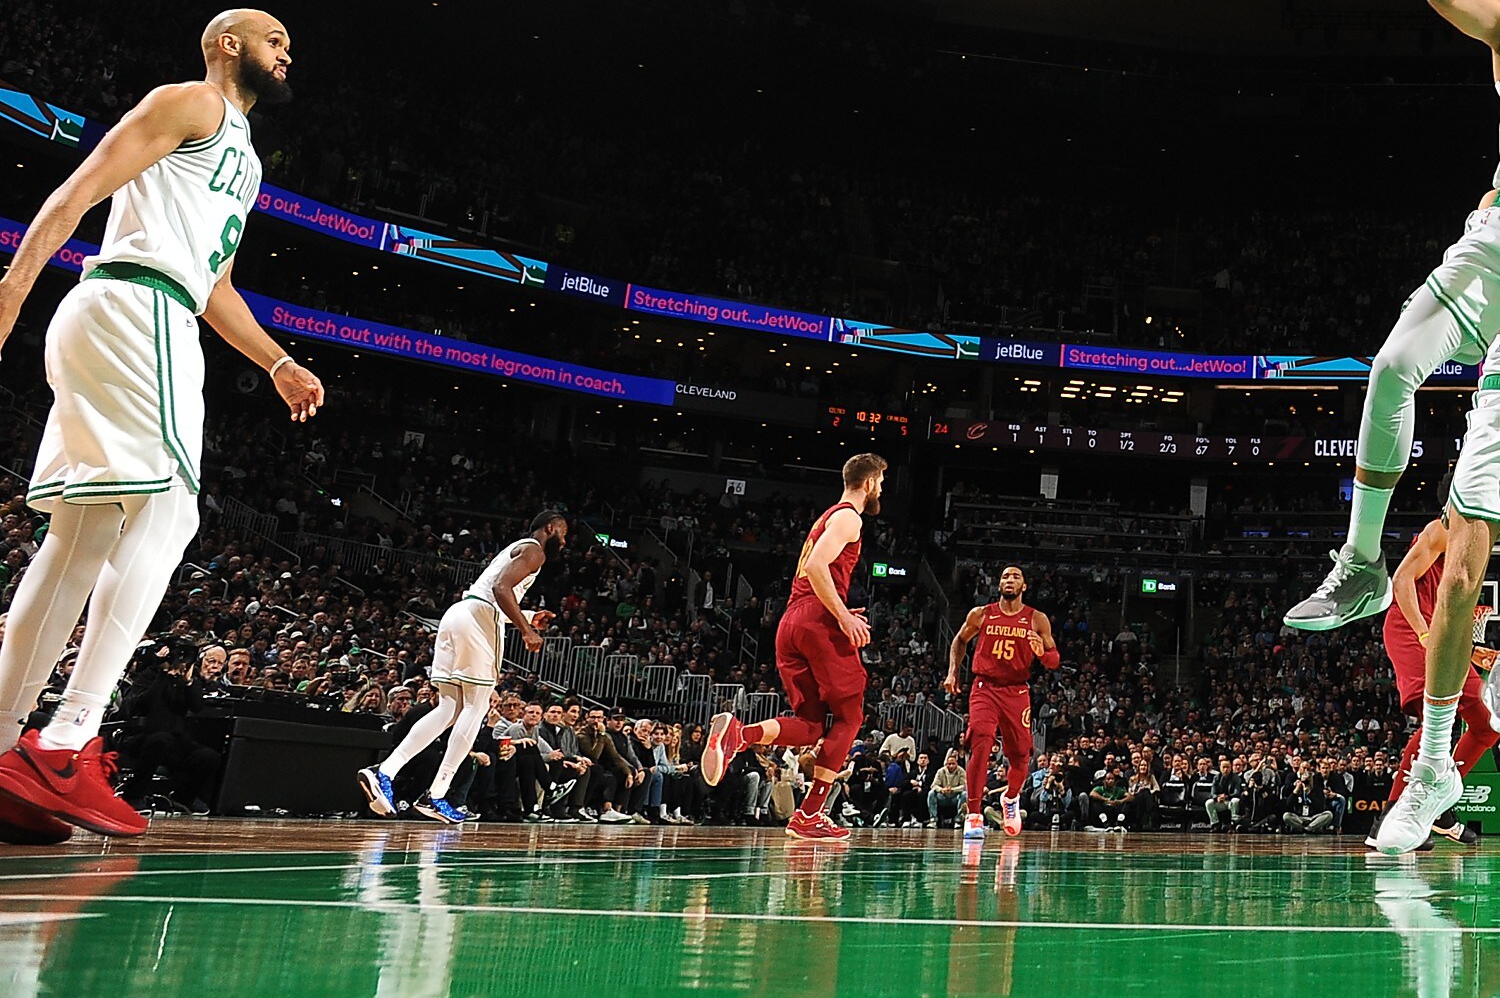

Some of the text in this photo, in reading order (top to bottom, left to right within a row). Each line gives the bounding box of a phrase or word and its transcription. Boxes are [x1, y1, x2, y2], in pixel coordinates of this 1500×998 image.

[208, 214, 243, 274] 9
[561, 272, 610, 298] jetBlue
[634, 290, 719, 321] Stretching
[273, 306, 626, 394] Stretch out with the most legroom in coach.
[995, 342, 1044, 361] jetBlue
[1069, 348, 1149, 373] Stretching
[1432, 364, 1463, 375] Blue
[676, 383, 737, 401] CLEVELAND
[833, 417, 840, 427] 2
[935, 423, 948, 434] 24
[1089, 439, 1259, 456] 0 1/2 2/3 67 7 0
[1314, 440, 1424, 458] CLEVEL 5
[609, 538, 628, 549] Bank
[874, 565, 906, 577] TD Bank
[1144, 580, 1176, 592] TD Bank
[985, 625, 1027, 639] CLEVELAND
[992, 639, 1016, 661] 45
[1467, 804, 1497, 813] balance
